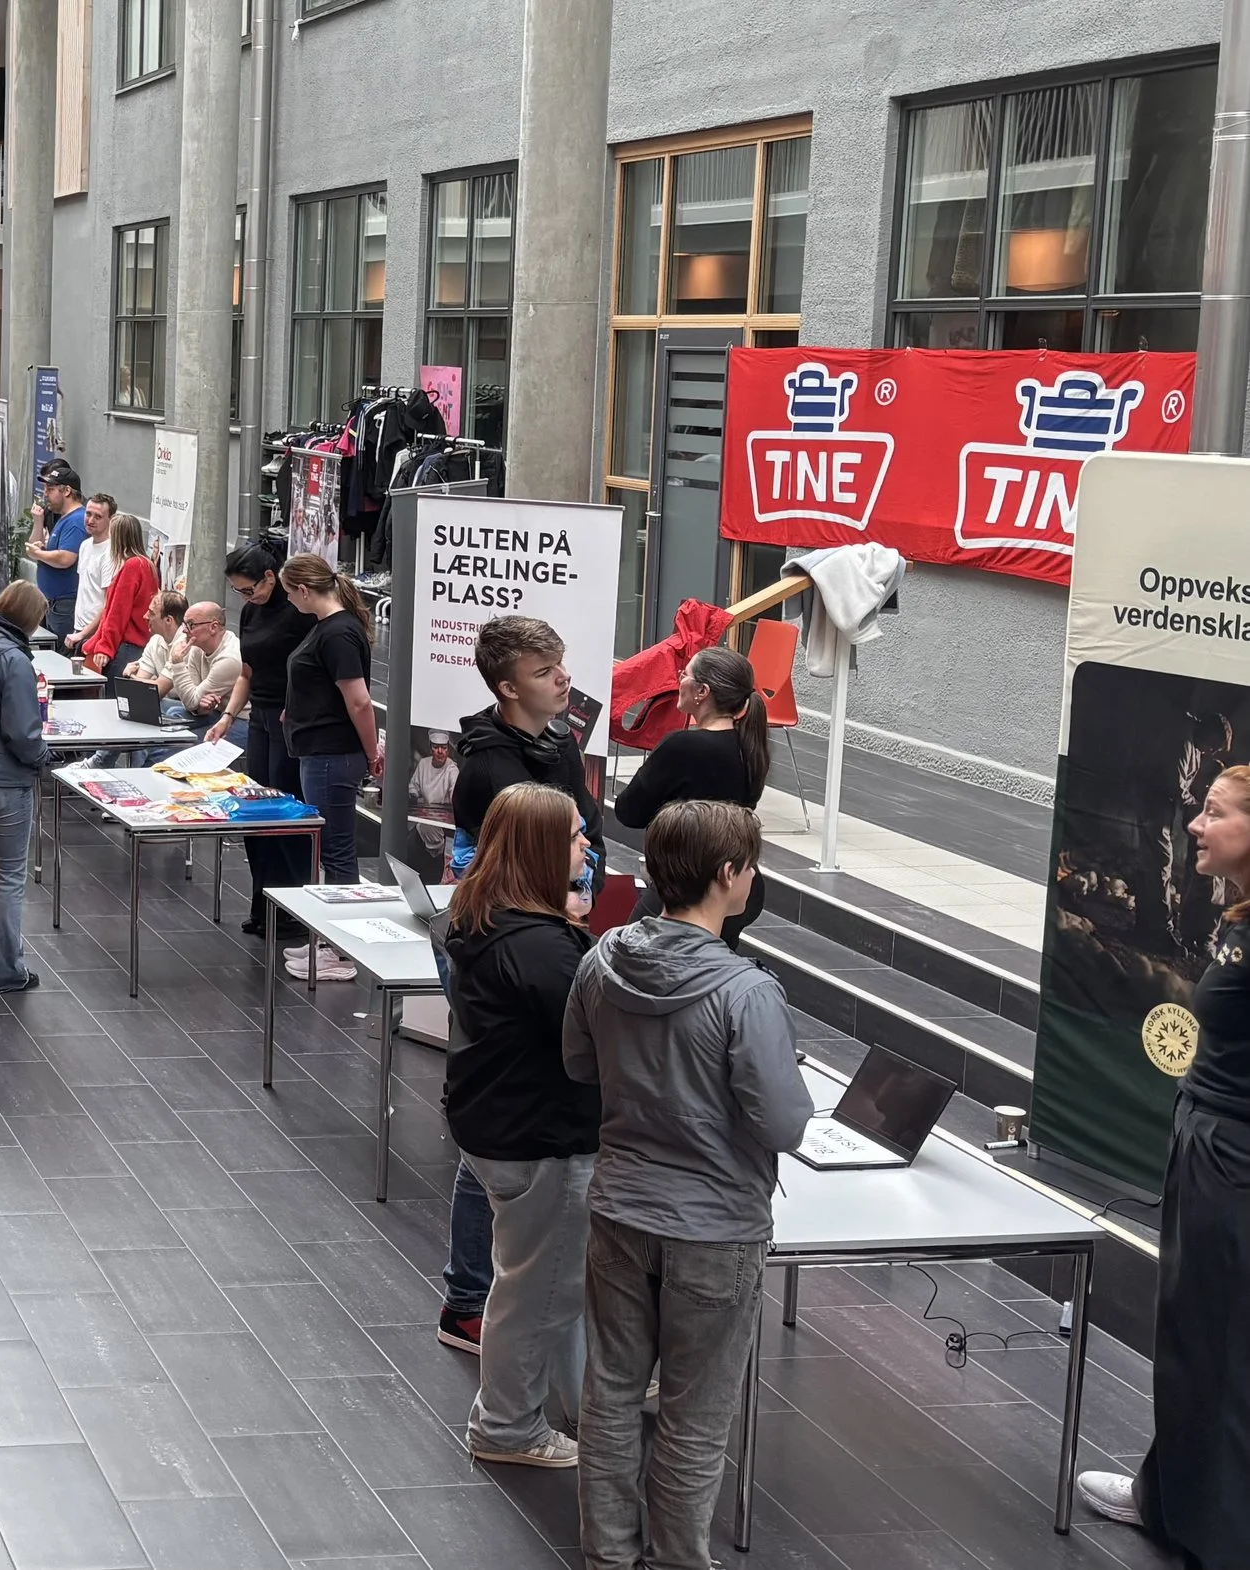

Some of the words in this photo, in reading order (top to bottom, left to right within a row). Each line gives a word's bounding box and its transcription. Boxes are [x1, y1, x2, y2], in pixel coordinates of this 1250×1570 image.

[766, 450, 862, 504] TINE
[983, 466, 1076, 534] TIN
[433, 525, 529, 553] SULTEN
[539, 530, 572, 556] PÅ
[432, 552, 578, 585] LÆRLINGE-
[432, 581, 524, 610] PLASS?
[1139, 567, 1250, 604] Oppveks
[430, 618, 482, 633] INDUSTRI
[1113, 605, 1250, 642] verdenskla
[429, 652, 477, 667] PØLSEMA
[1146, 1007, 1166, 1033] NORSK
[815, 1128, 866, 1152] Norsk
